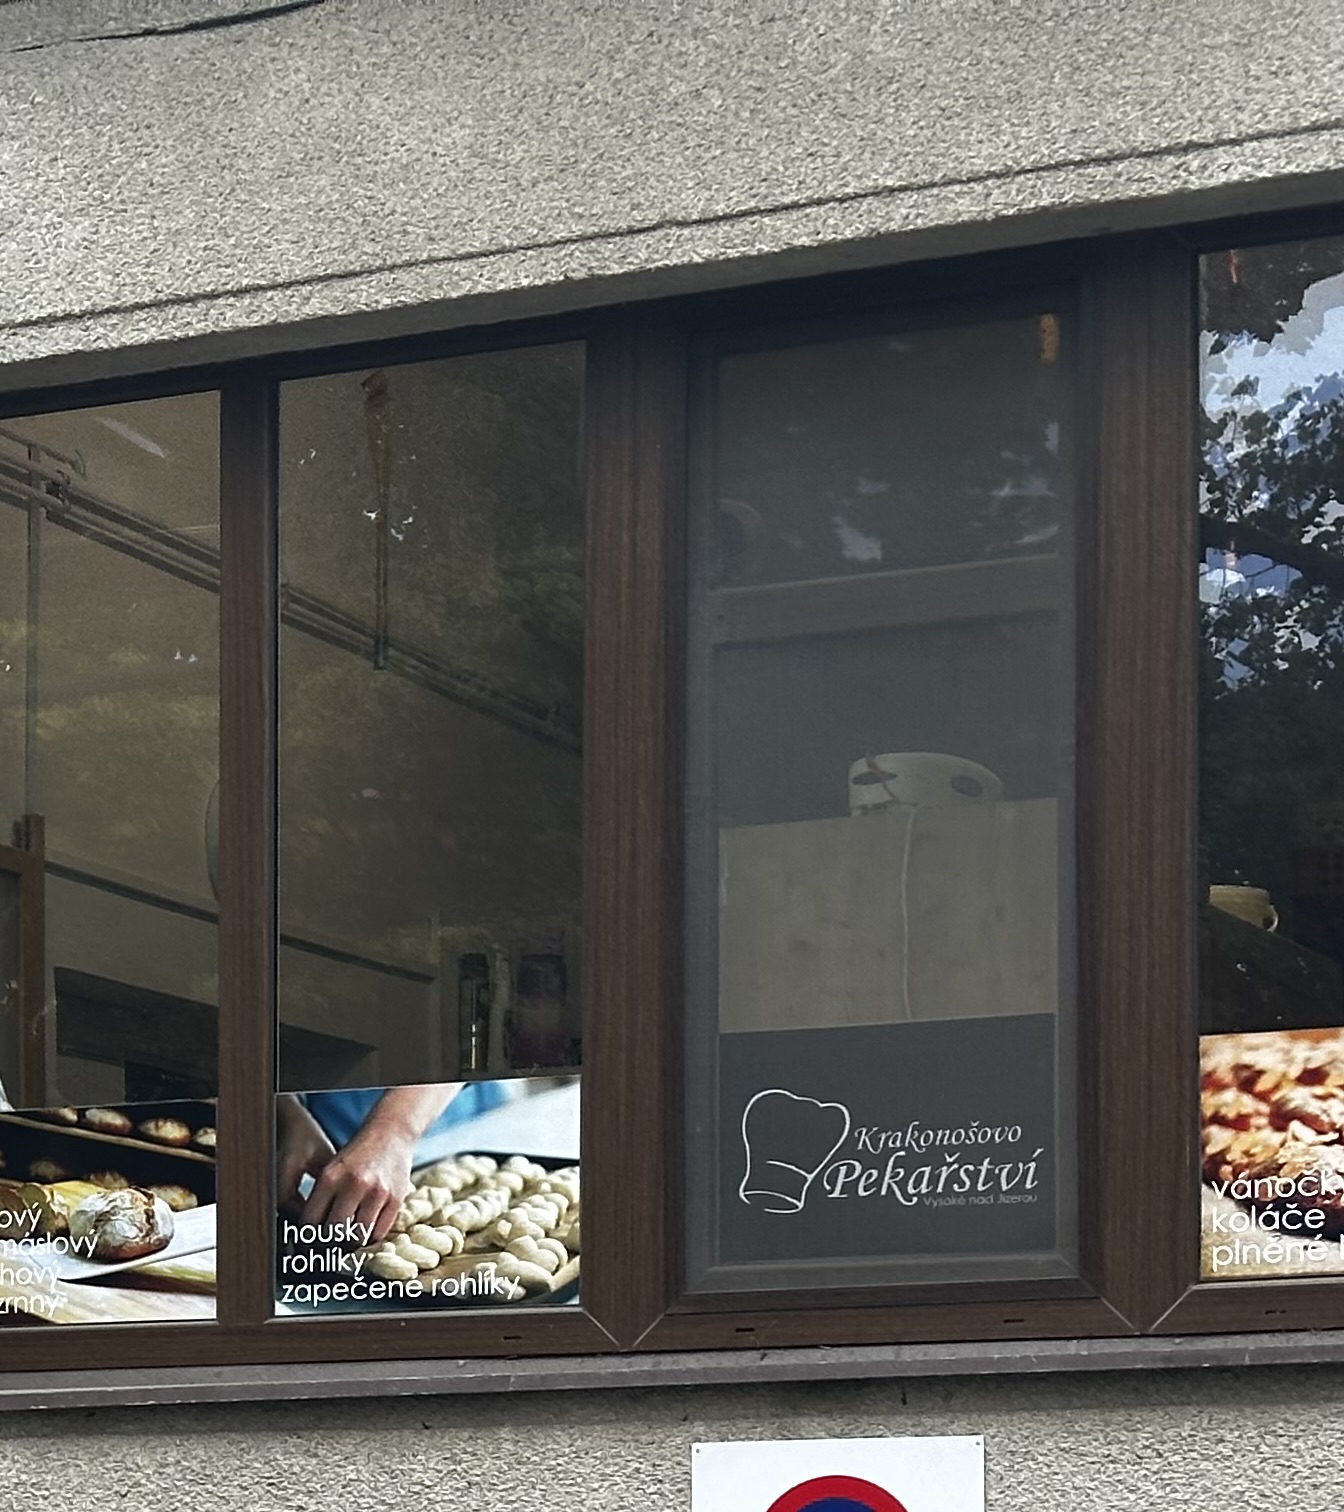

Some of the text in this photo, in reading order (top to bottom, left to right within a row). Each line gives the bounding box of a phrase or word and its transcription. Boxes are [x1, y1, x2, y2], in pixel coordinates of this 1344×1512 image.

[854, 1120, 1023, 1154] Krakonošovo
[823, 1147, 1045, 1207] Pekařství
[922, 1193, 1039, 1209] Vysoké nad Jizerou
[282, 1215, 376, 1246] housky
[1212, 1202, 1326, 1233] koláče
[282, 1246, 368, 1276] rohlíky
[1212, 1233, 1329, 1273] plněné
[281, 1267, 521, 1308] zapečené rohlíky
